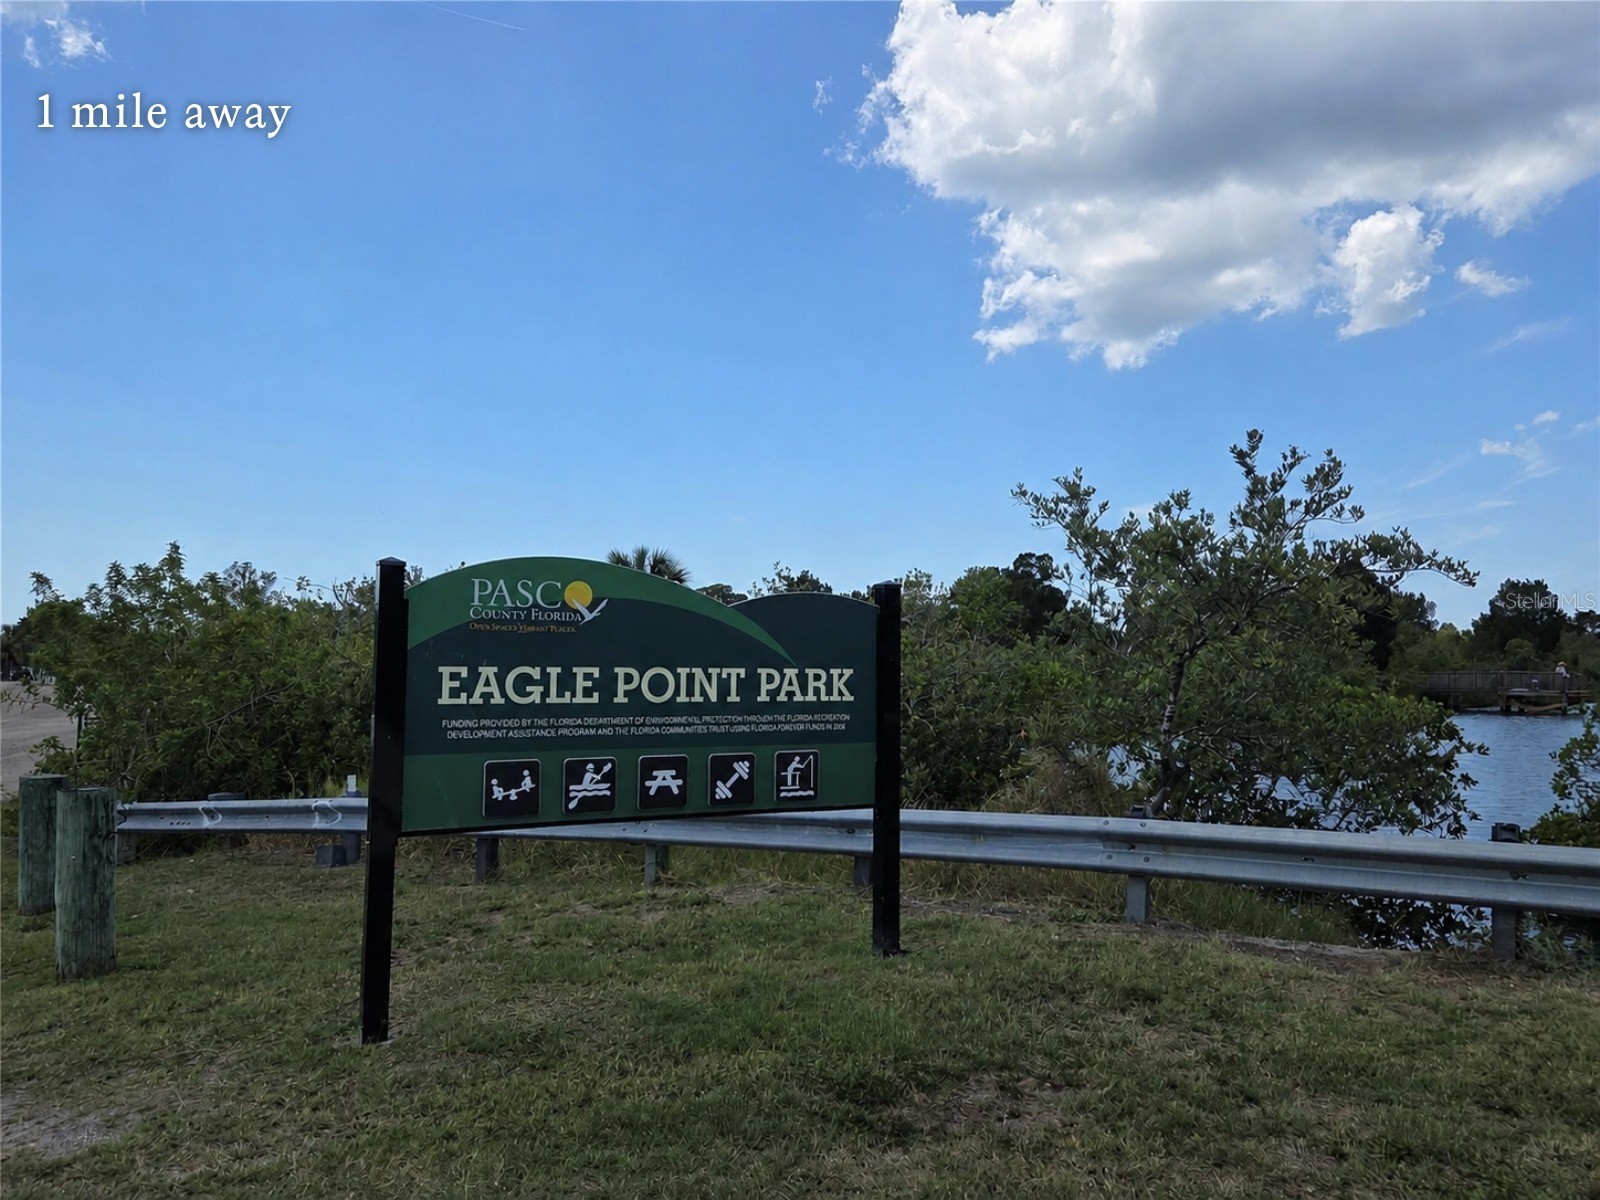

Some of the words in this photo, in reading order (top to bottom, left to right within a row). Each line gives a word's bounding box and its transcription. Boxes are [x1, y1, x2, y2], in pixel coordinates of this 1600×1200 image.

[469, 606, 527, 620] COUNTY
[531, 608, 582, 621] FLORIDA
[437, 665, 600, 705] EAGLE
[613, 666, 746, 703] POINT
[757, 667, 855, 702] PARK
[442, 719, 478, 728] FUNDING
[480, 719, 520, 728] PROVIDED
[521, 718, 532, 727] BY
[533, 718, 548, 727] THE
[549, 717, 582, 726] FLORIDA
[583, 716, 634, 726] DEPARTMENT
[634, 716, 644, 725] OF
[447, 729, 507, 739] DEVELOPMENT
[507, 728, 557, 738] ASSISTANCE
[558, 727, 597, 737] PROGRAM
[597, 727, 614, 736] AND
[615, 726, 629, 735] THE
[630, 726, 660, 735] FLORIDA
[660, 725, 708, 735] COMMUNITIES
[708, 724, 730, 733] TRUST
